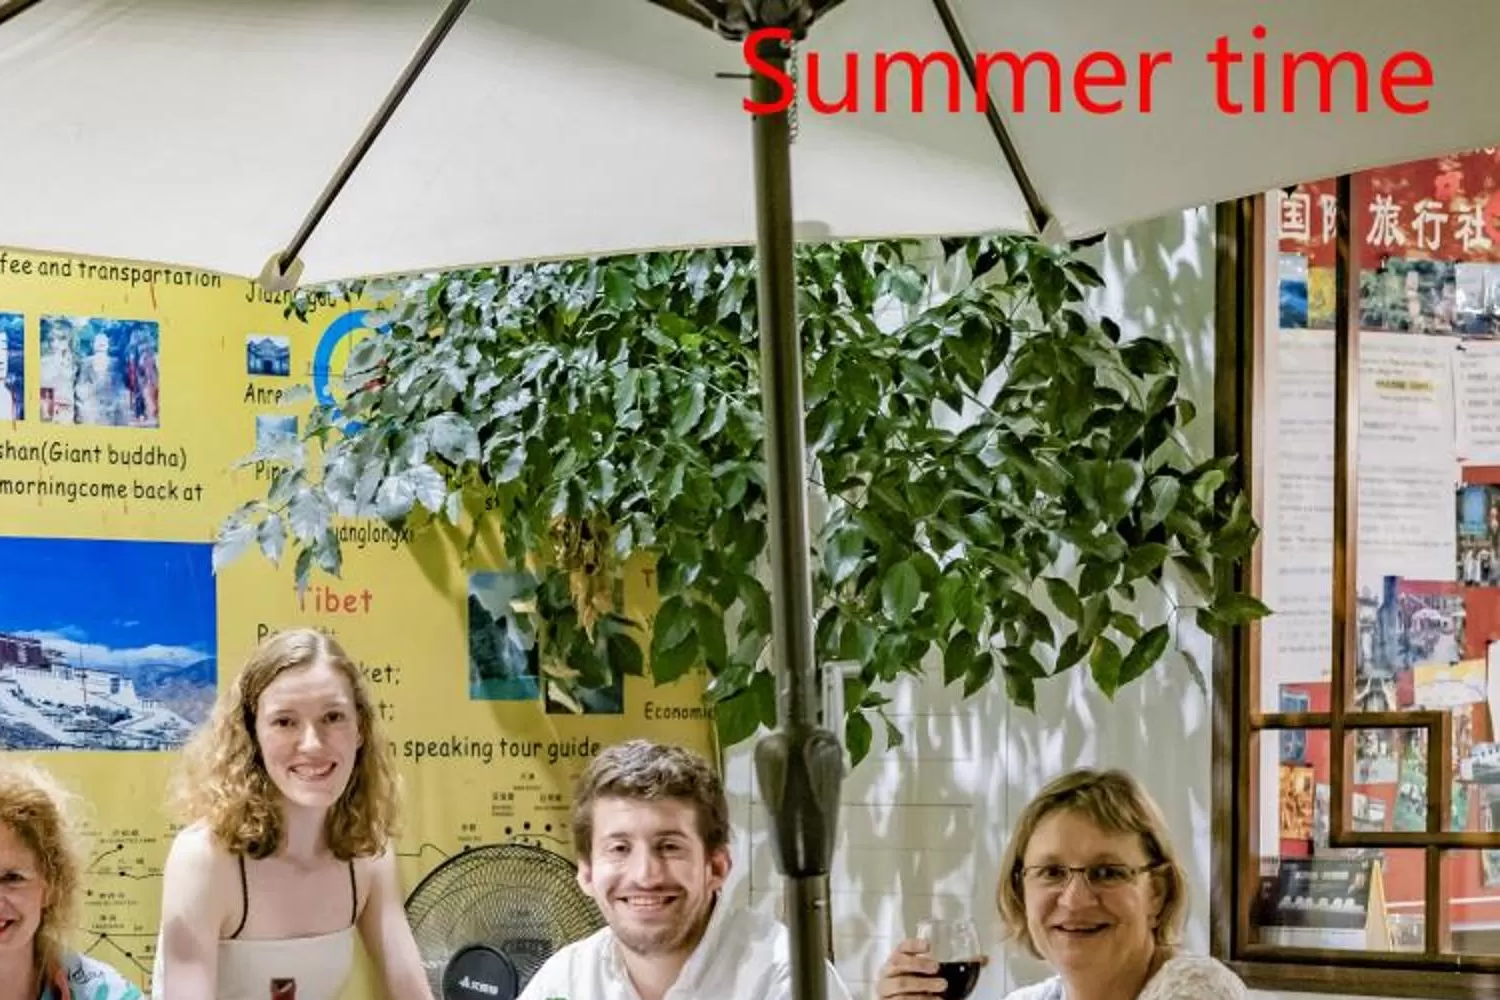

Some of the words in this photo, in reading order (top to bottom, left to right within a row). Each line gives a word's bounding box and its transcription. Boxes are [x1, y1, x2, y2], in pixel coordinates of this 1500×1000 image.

[0, 252, 33, 276] fee
[38, 259, 72, 278] and
[108, 445, 188, 471] buddha)
[132, 480, 179, 501] back
[183, 485, 204, 502] at
[335, 519, 415, 550] anglongxi
[403, 737, 493, 764] speaking
[499, 738, 541, 758] tour
[547, 737, 599, 765] guide
